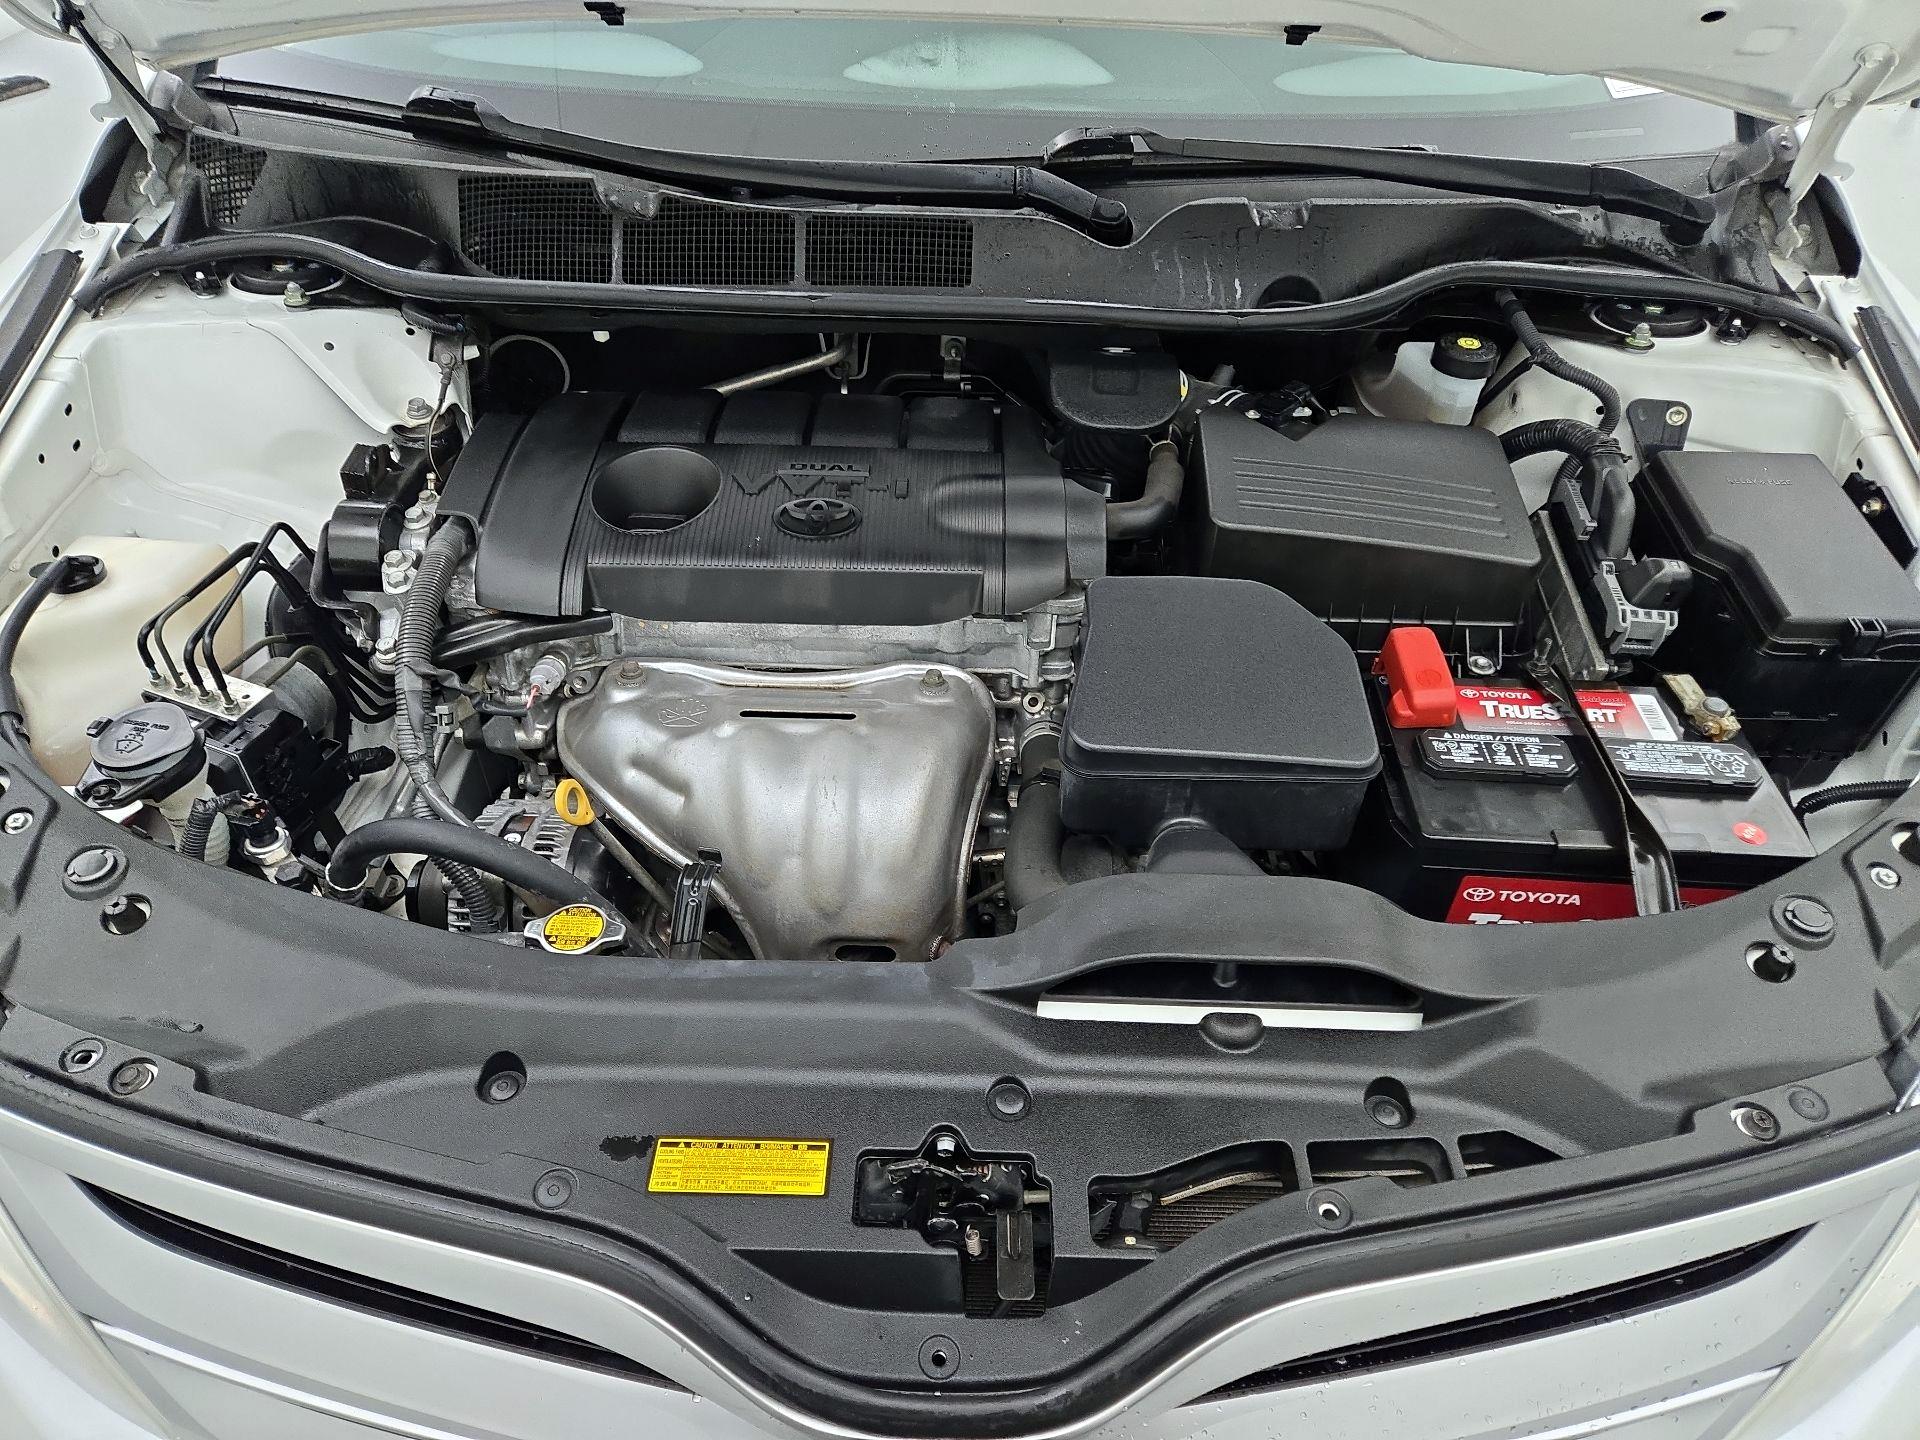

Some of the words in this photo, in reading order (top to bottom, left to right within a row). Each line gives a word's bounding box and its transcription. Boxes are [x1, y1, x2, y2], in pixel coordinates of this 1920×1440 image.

[790, 463, 861, 472] DUAL
[1480, 690, 1532, 700] TOYOTA
[1453, 733, 1494, 741] DANGER
[1502, 735, 1540, 743] POISON
[1498, 890, 1581, 906] TOYOTA
